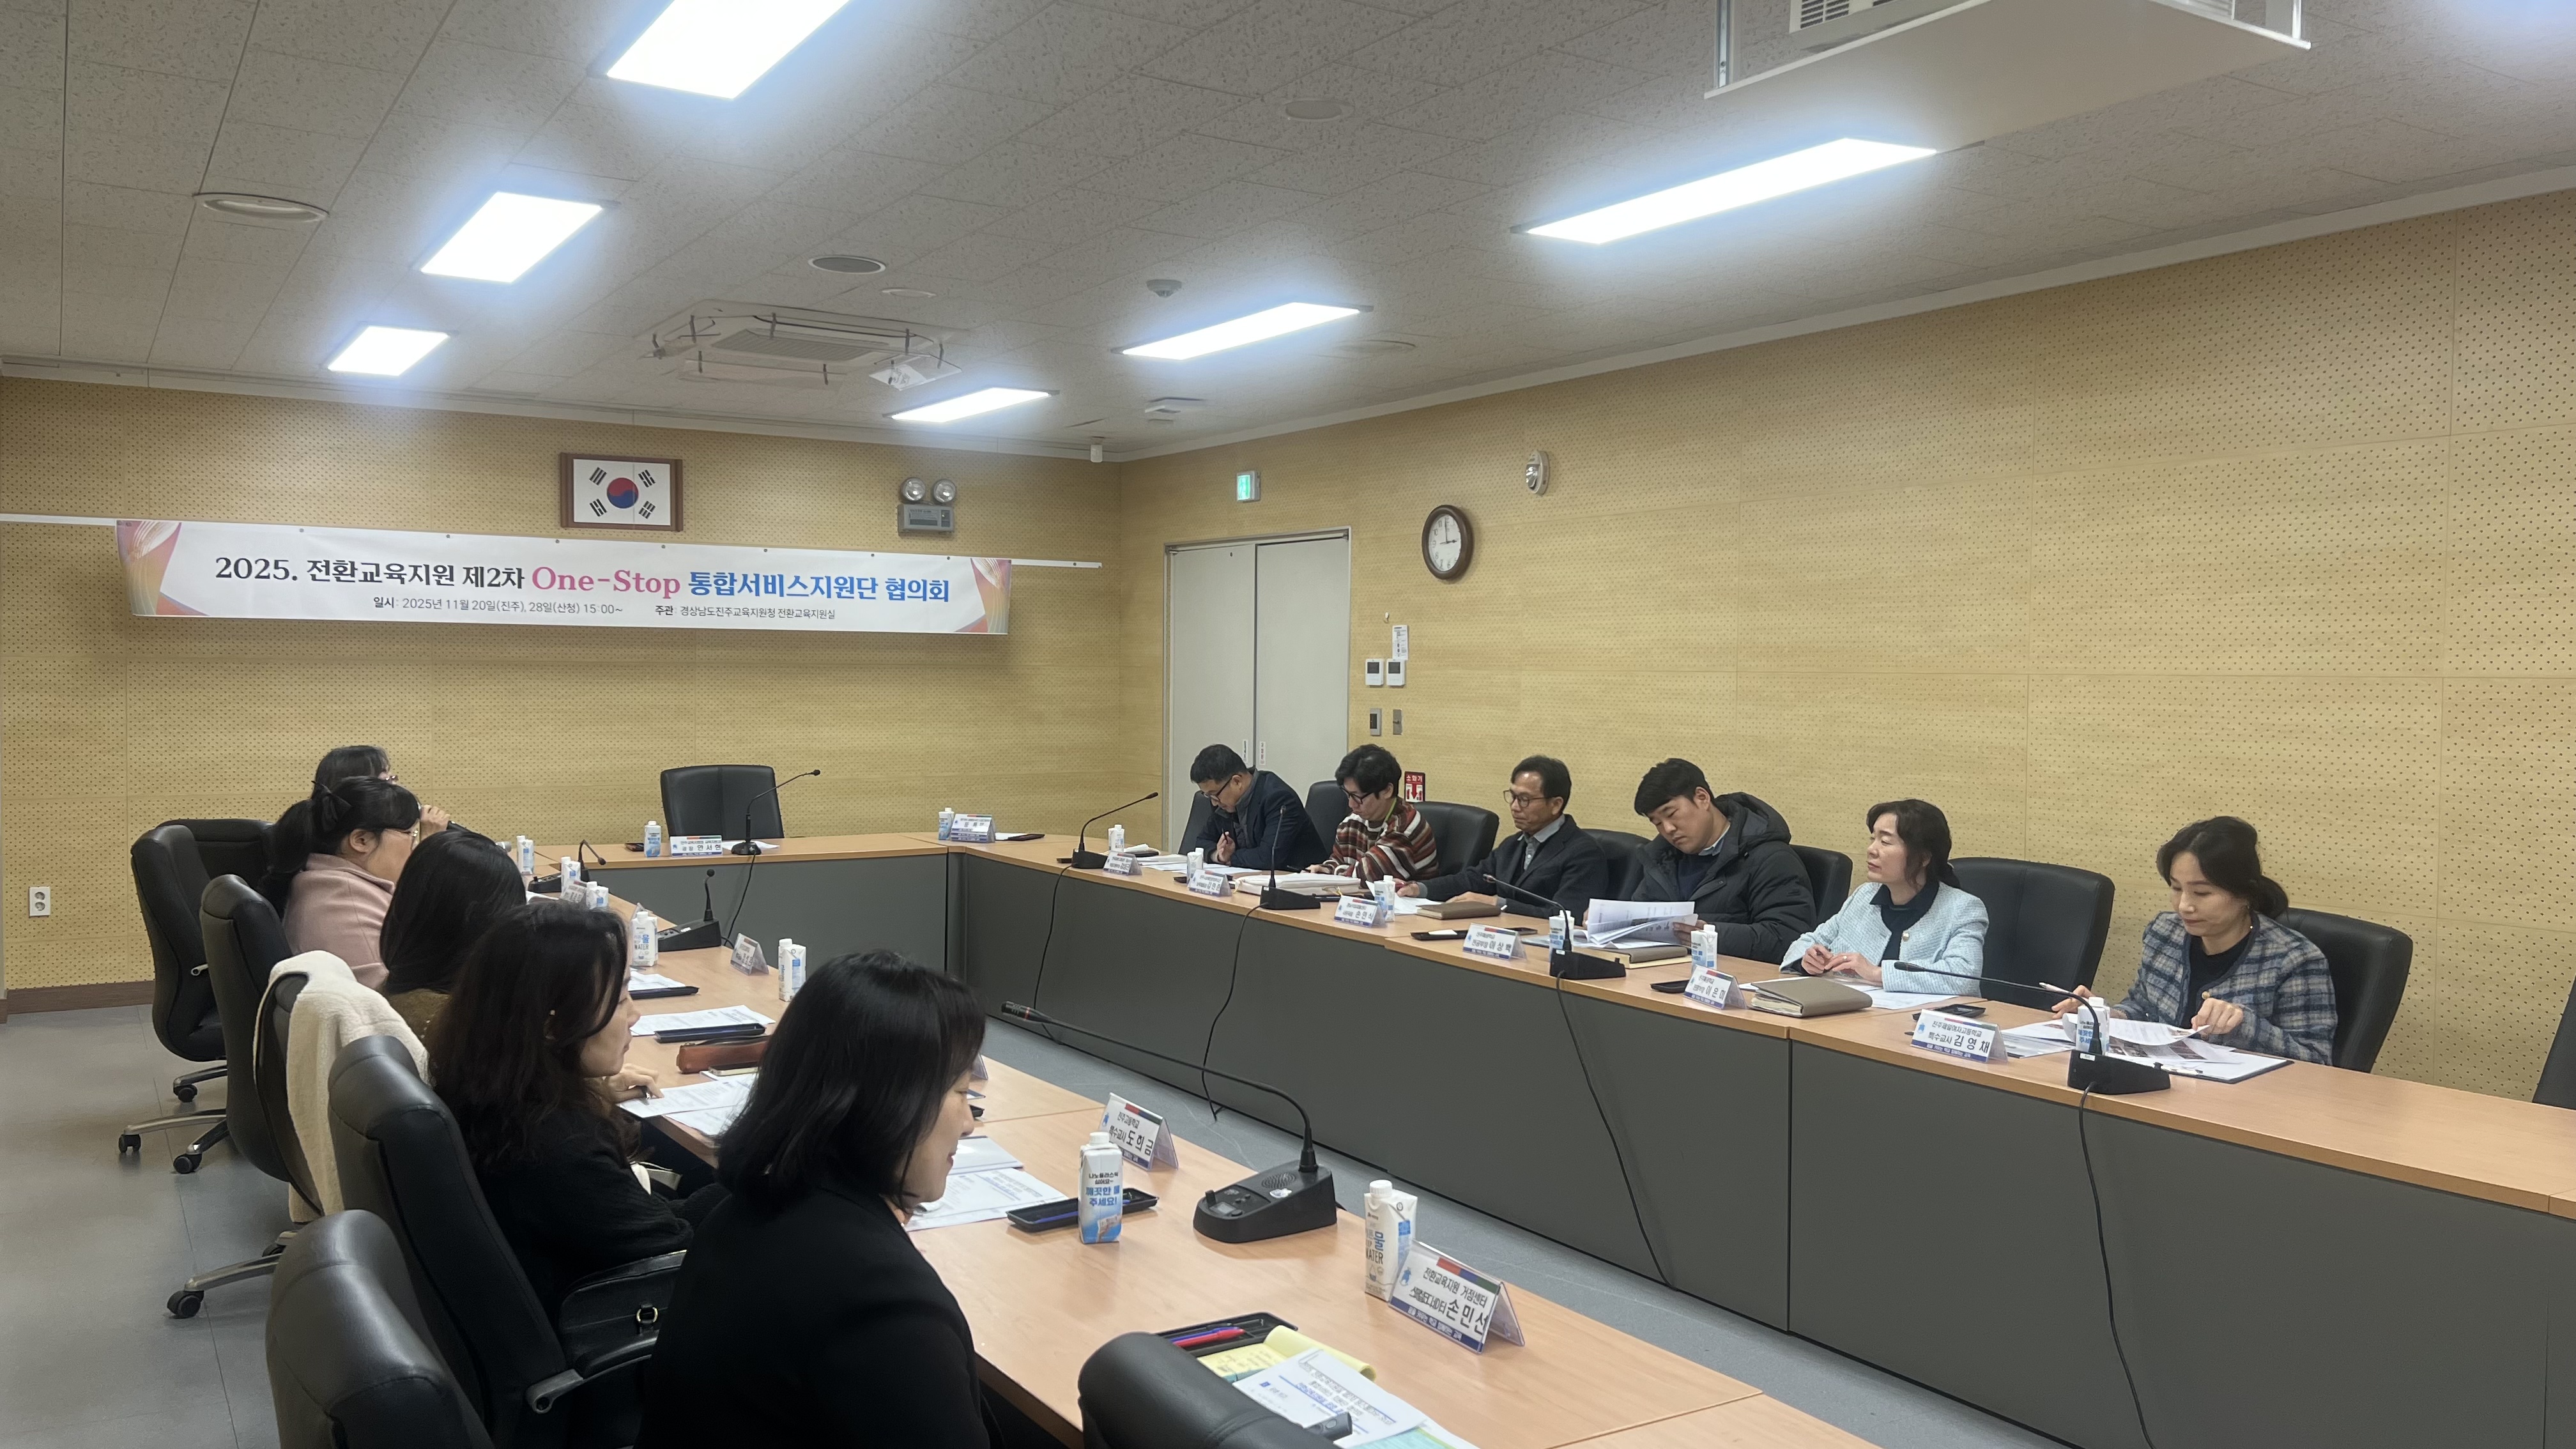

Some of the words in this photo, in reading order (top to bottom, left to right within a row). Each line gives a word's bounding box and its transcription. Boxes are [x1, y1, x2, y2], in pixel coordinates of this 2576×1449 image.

[215, 557, 298, 582] 2025.
[306, 559, 455, 587] 전환교육지원
[462, 565, 525, 590] 제2차
[532, 566, 681, 599] One-Stop
[687, 571, 878, 601] 통합서비스지원단
[885, 577, 949, 602] 협의회
[402, 598, 442, 610] 2025년
[446, 599, 470, 611] 11월
[777, 608, 836, 620] 전환교육지원실
[1954, 1035, 1991, 1054] 김영채
[1126, 1130, 1154, 1156] 도희금
[1089, 1197, 1117, 1206] 주세요!
[1374, 1231, 1385, 1252] 물
[1423, 1267, 1460, 1294] 전환교육지원
[1446, 1299, 1489, 1335] 손민선
